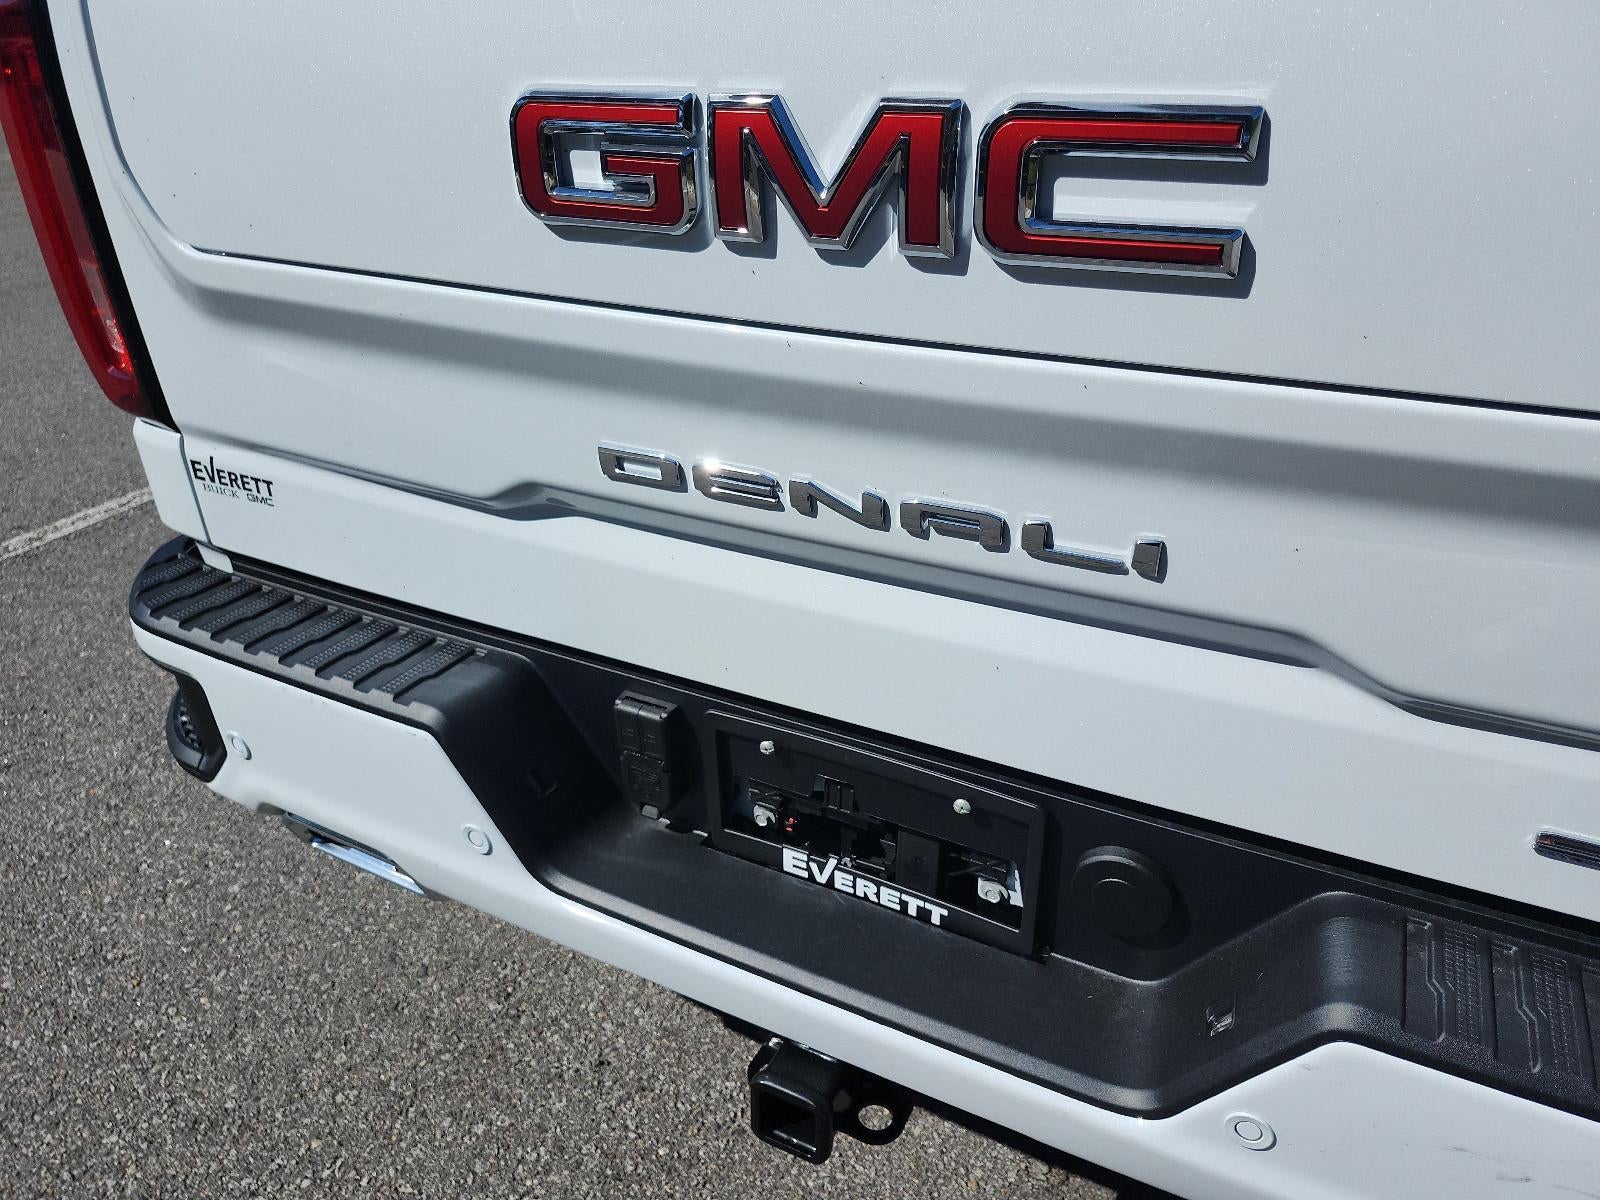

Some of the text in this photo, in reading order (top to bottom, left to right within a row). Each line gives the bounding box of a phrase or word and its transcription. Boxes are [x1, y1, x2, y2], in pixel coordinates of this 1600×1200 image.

[509, 91, 1266, 280] GMC
[190, 456, 273, 497] EVERETT
[203, 483, 275, 507] BUICK GMC
[597, 444, 1166, 581] DENALI
[782, 846, 949, 926] EVERETT
